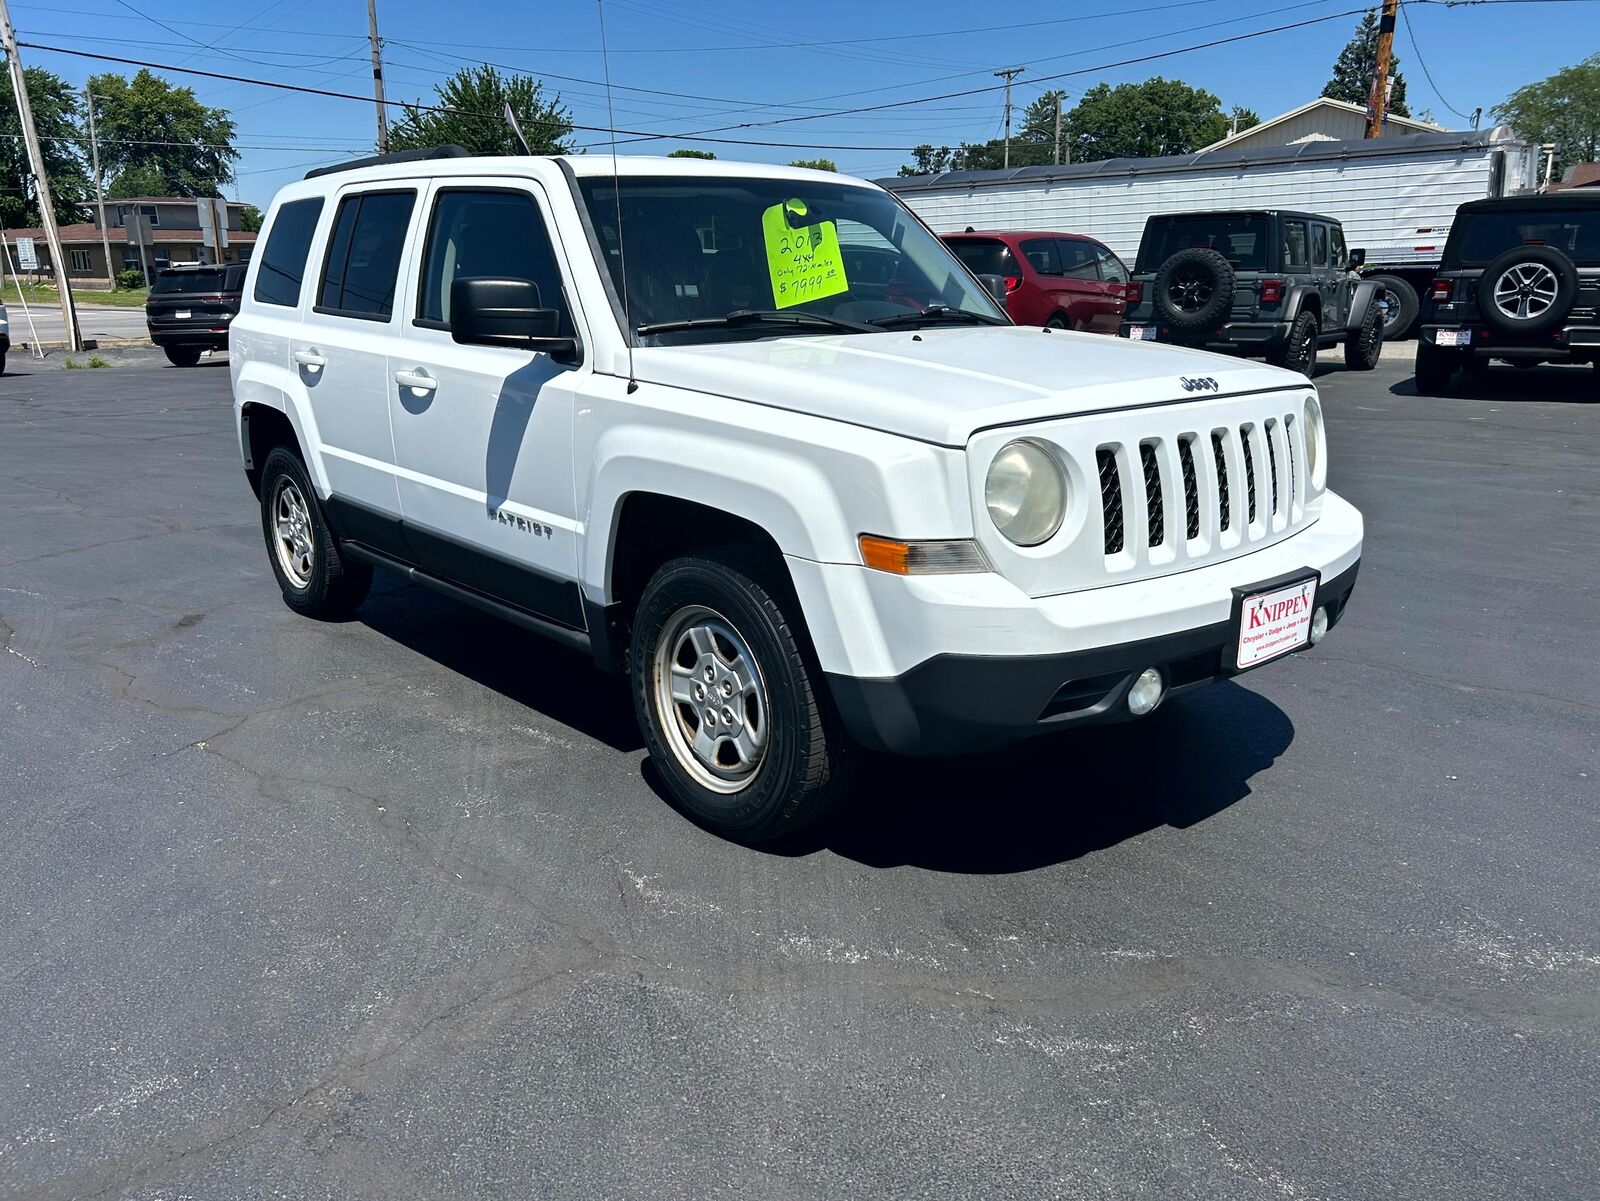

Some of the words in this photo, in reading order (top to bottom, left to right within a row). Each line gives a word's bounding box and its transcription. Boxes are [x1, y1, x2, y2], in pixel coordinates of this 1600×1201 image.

[780, 233, 823, 254] 2013
[1180, 376, 1219, 392] Jeep
[489, 509, 553, 540] PATRIOT
[1249, 593, 1310, 630] KNIPPEN
[1243, 632, 1265, 644] Chrysler
[1268, 626, 1283, 636] Dodge
[1286, 621, 1297, 630] Jeep
